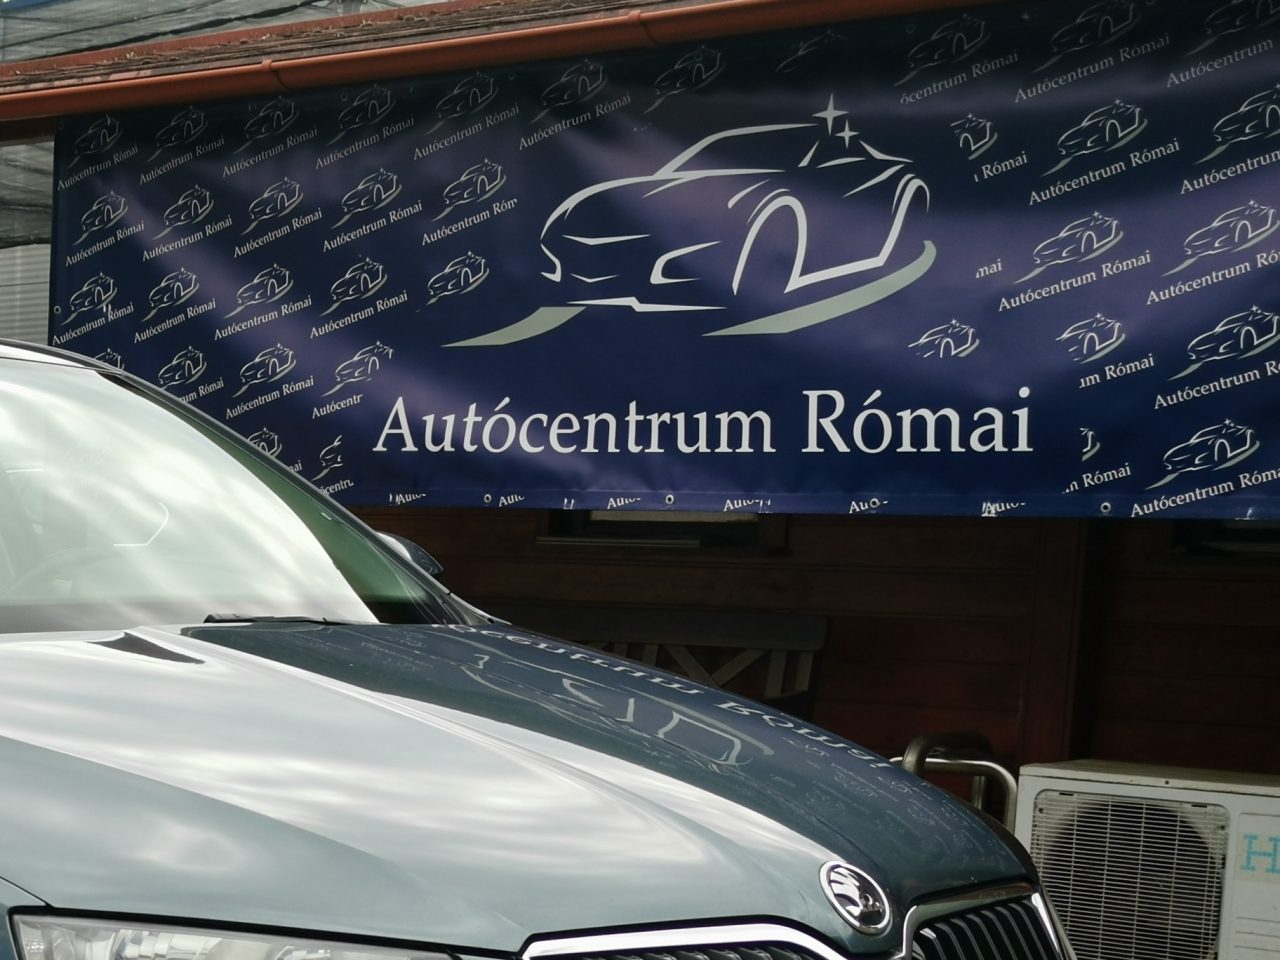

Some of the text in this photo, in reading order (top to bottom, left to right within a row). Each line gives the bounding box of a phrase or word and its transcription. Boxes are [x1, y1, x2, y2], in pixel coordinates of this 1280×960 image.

[971, 50, 1019, 82] Római
[1015, 32, 1170, 103] Autócentrum Római
[1167, 39, 1273, 88] Autócentrum
[413, 104, 520, 160] Autócentrum Római
[519, 94, 632, 150] Autócentrum Római
[139, 153, 193, 185] Autócentrum
[222, 145, 285, 178] Autócentrum
[316, 135, 380, 170] Autócentrum
[982, 150, 1028, 179] Római
[1029, 138, 1180, 206] Autócentrum Római
[65, 220, 145, 267] Autócentrum Római
[142, 214, 233, 262] Autócentrum Római
[234, 207, 323, 258] Autócentrum Római
[323, 199, 423, 252] Autócentrum Római
[422, 211, 490, 246] Autócentrum
[998, 249, 1151, 312] Autócentrum Római
[1146, 260, 1251, 305] Autócentrum
[52, 316, 106, 346] Autócentrum
[134, 298, 217, 344] Autócentrum Római
[214, 294, 312, 341] Autócentrum Római
[310, 290, 409, 339] Autócentrum Római
[198, 377, 224, 397] Római
[1105, 353, 1155, 381] Római
[1154, 368, 1261, 409] Autócentrum
[226, 391, 281, 420] Autócentrum
[282, 375, 315, 395] Római
[373, 387, 1034, 453] Autócentrum Római
[1082, 462, 1131, 488] Római
[1130, 480, 1235, 518] Autócentrum
